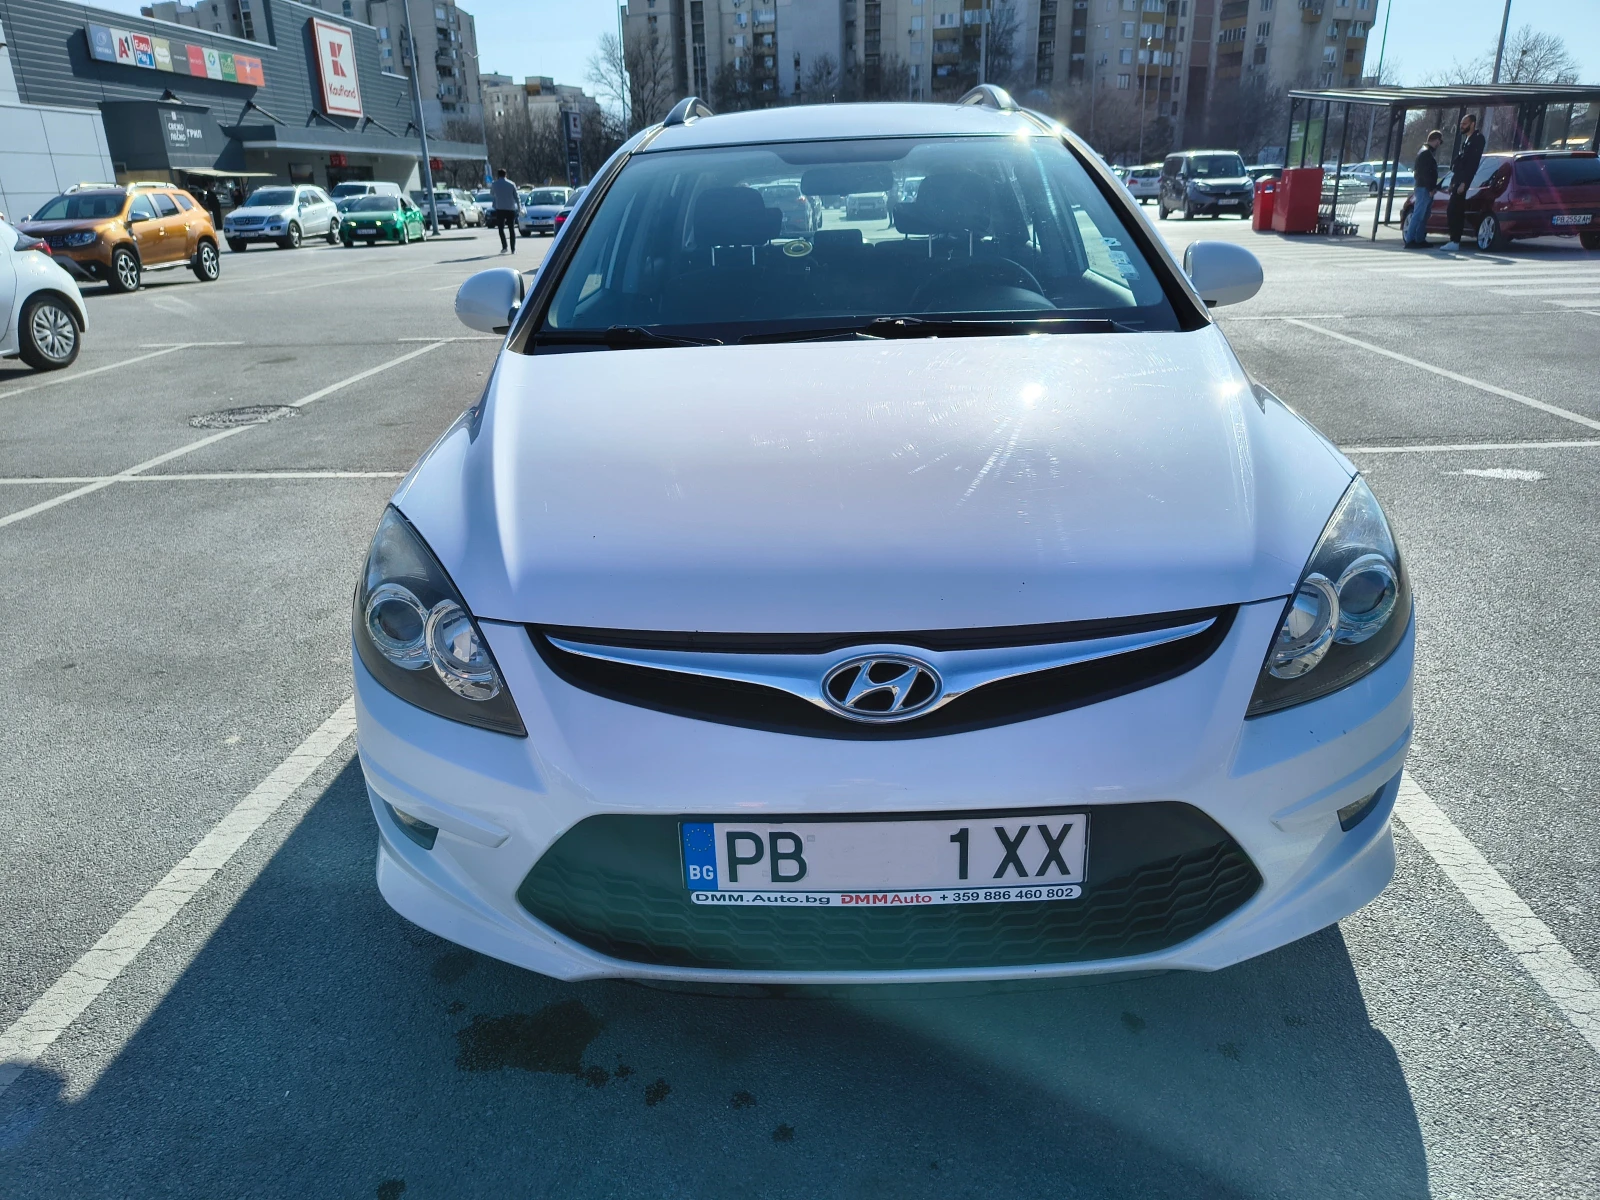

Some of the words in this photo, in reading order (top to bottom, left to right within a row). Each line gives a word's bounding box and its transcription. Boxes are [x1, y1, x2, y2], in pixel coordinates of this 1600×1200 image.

[119, 36, 130, 58] A1
[134, 39, 151, 53] Easy
[136, 51, 150, 65] Pay
[328, 82, 357, 99] Kaufland
[186, 129, 203, 138] ГРИЛ
[726, 831, 807, 882] PB
[949, 827, 969, 879] 1
[992, 823, 1074, 878] XX
[689, 865, 714, 880] BG
[695, 893, 831, 905] DMM.Auto.bg
[983, 890, 1011, 900] 886
[1014, 889, 1042, 899] 460
[1046, 888, 1074, 898] 802
